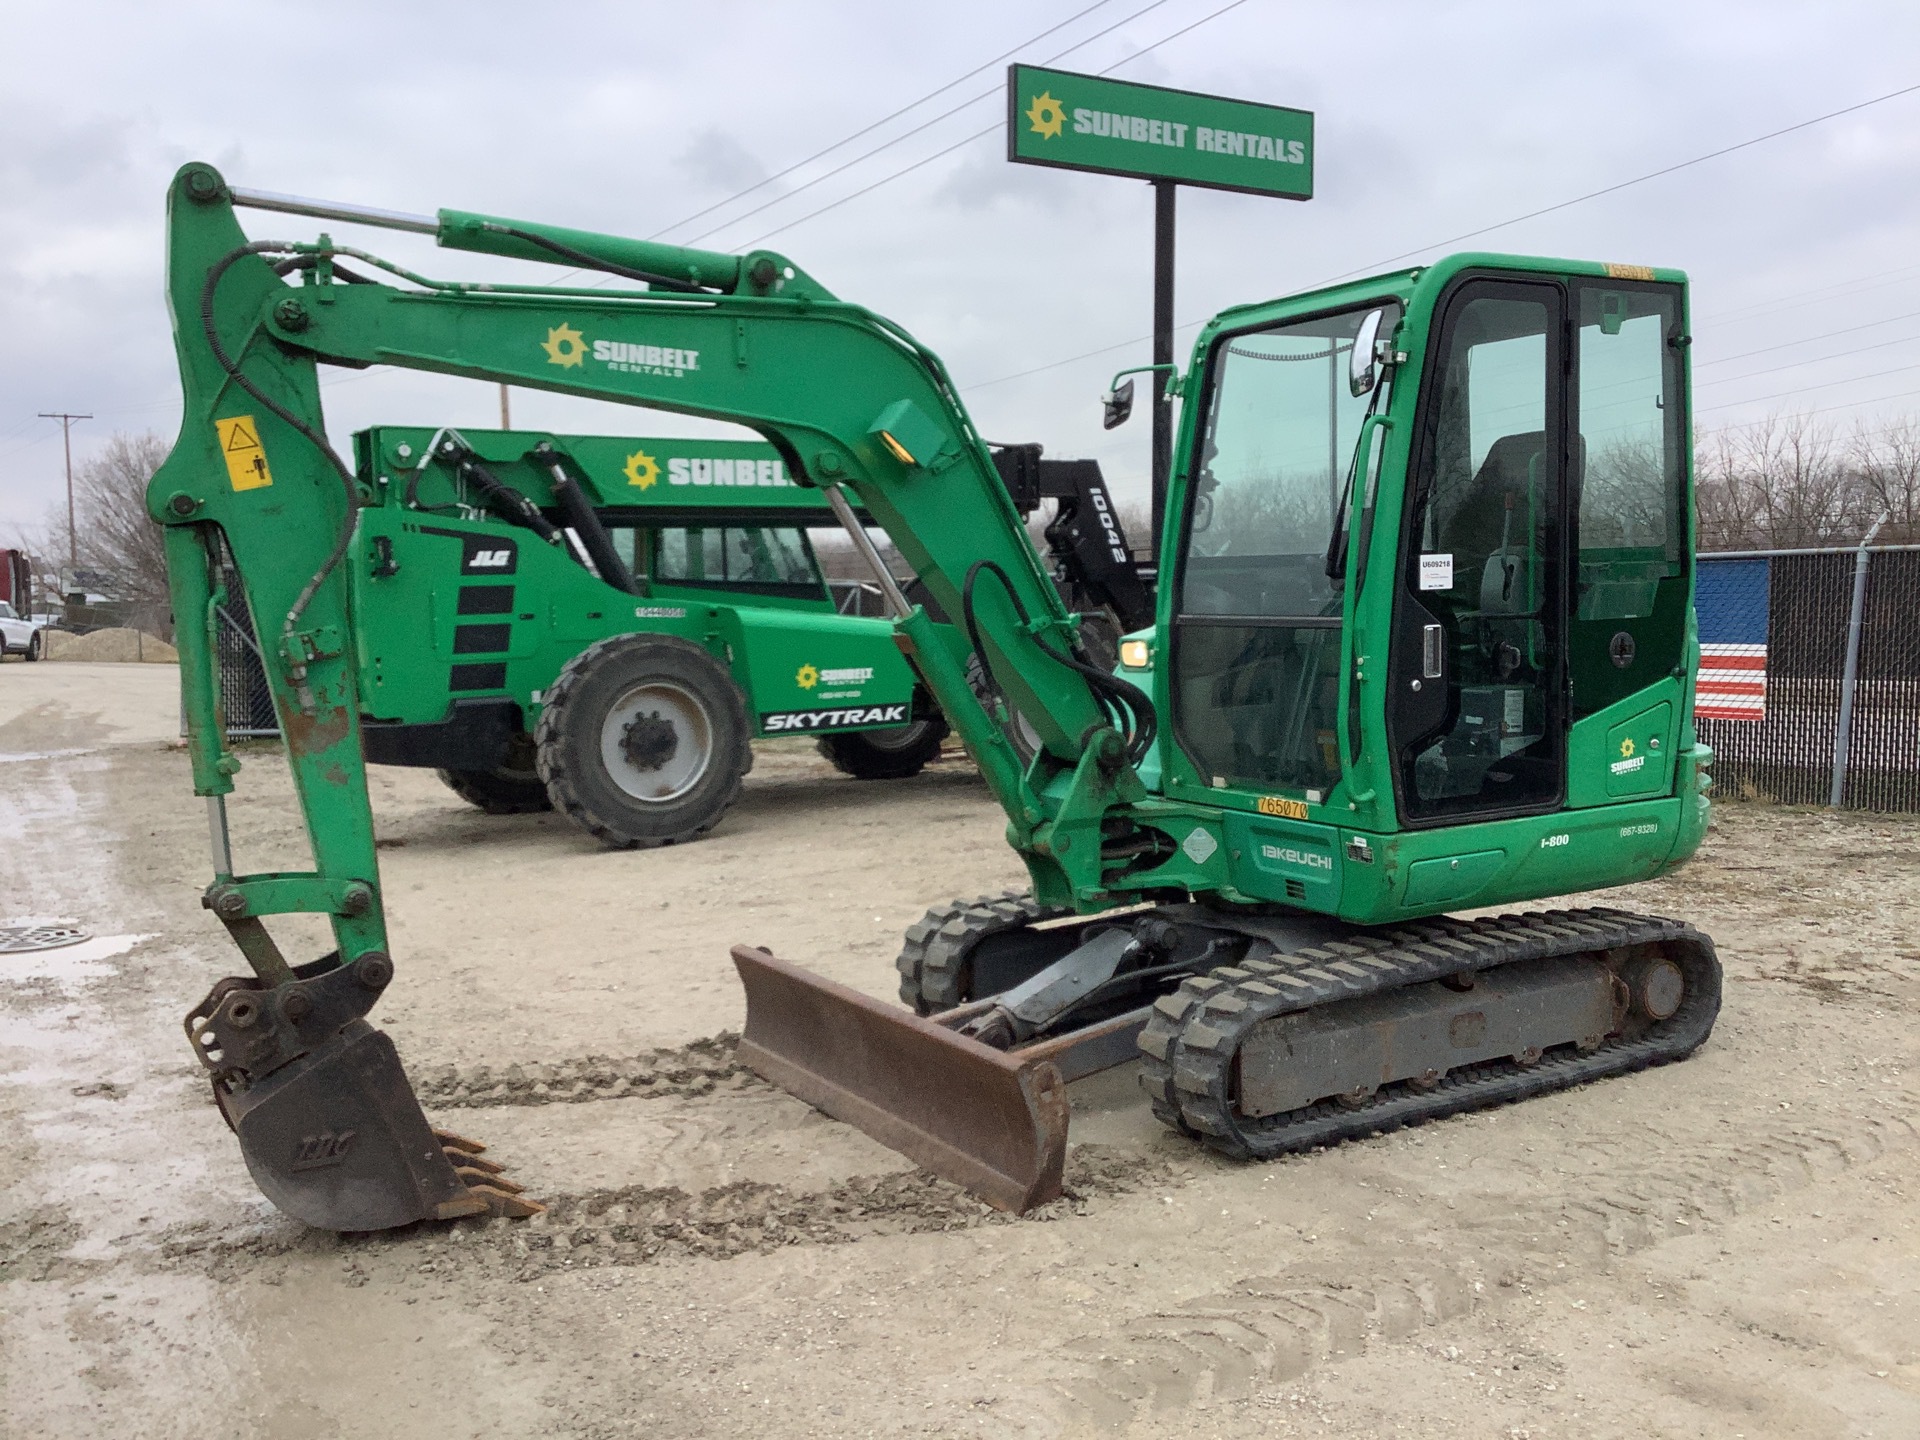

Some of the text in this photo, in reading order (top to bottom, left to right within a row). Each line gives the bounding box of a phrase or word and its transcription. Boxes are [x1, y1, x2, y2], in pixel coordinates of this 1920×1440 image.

[1073, 108, 1305, 165] SUNBELT RENTALS
[593, 340, 699, 370] SUNBELT
[607, 362, 684, 378] RENTALS
[668, 457, 799, 487] SUNBEL
[1090, 487, 1127, 563] 10042
[469, 550, 511, 567] JLG
[820, 667, 874, 681] SUNBELT
[764, 706, 906, 731] SKYTRAK
[1610, 755, 1645, 773] SUNBELT
[1260, 798, 1308, 819] 765070
